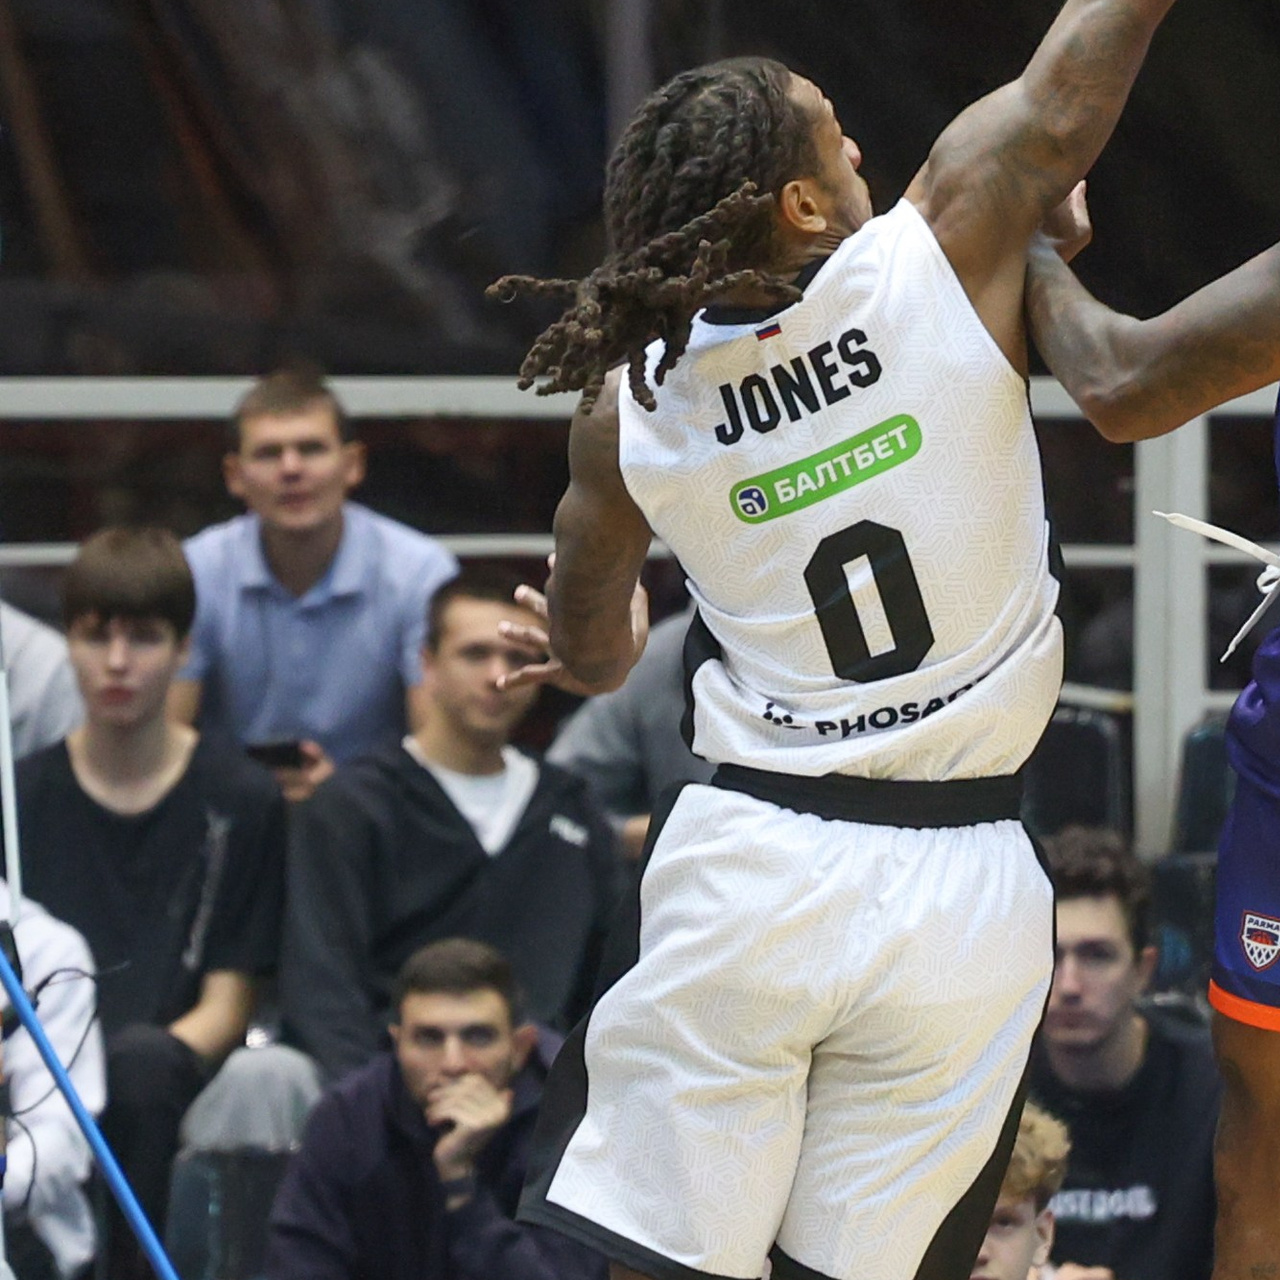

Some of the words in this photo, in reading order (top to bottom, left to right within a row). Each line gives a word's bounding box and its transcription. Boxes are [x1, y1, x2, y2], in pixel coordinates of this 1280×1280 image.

[714, 328, 882, 446] JONES
[774, 423, 909, 505] БАЛТБЕТ
[803, 519, 935, 683] 0
[1247, 917, 1280, 931] PARMA
